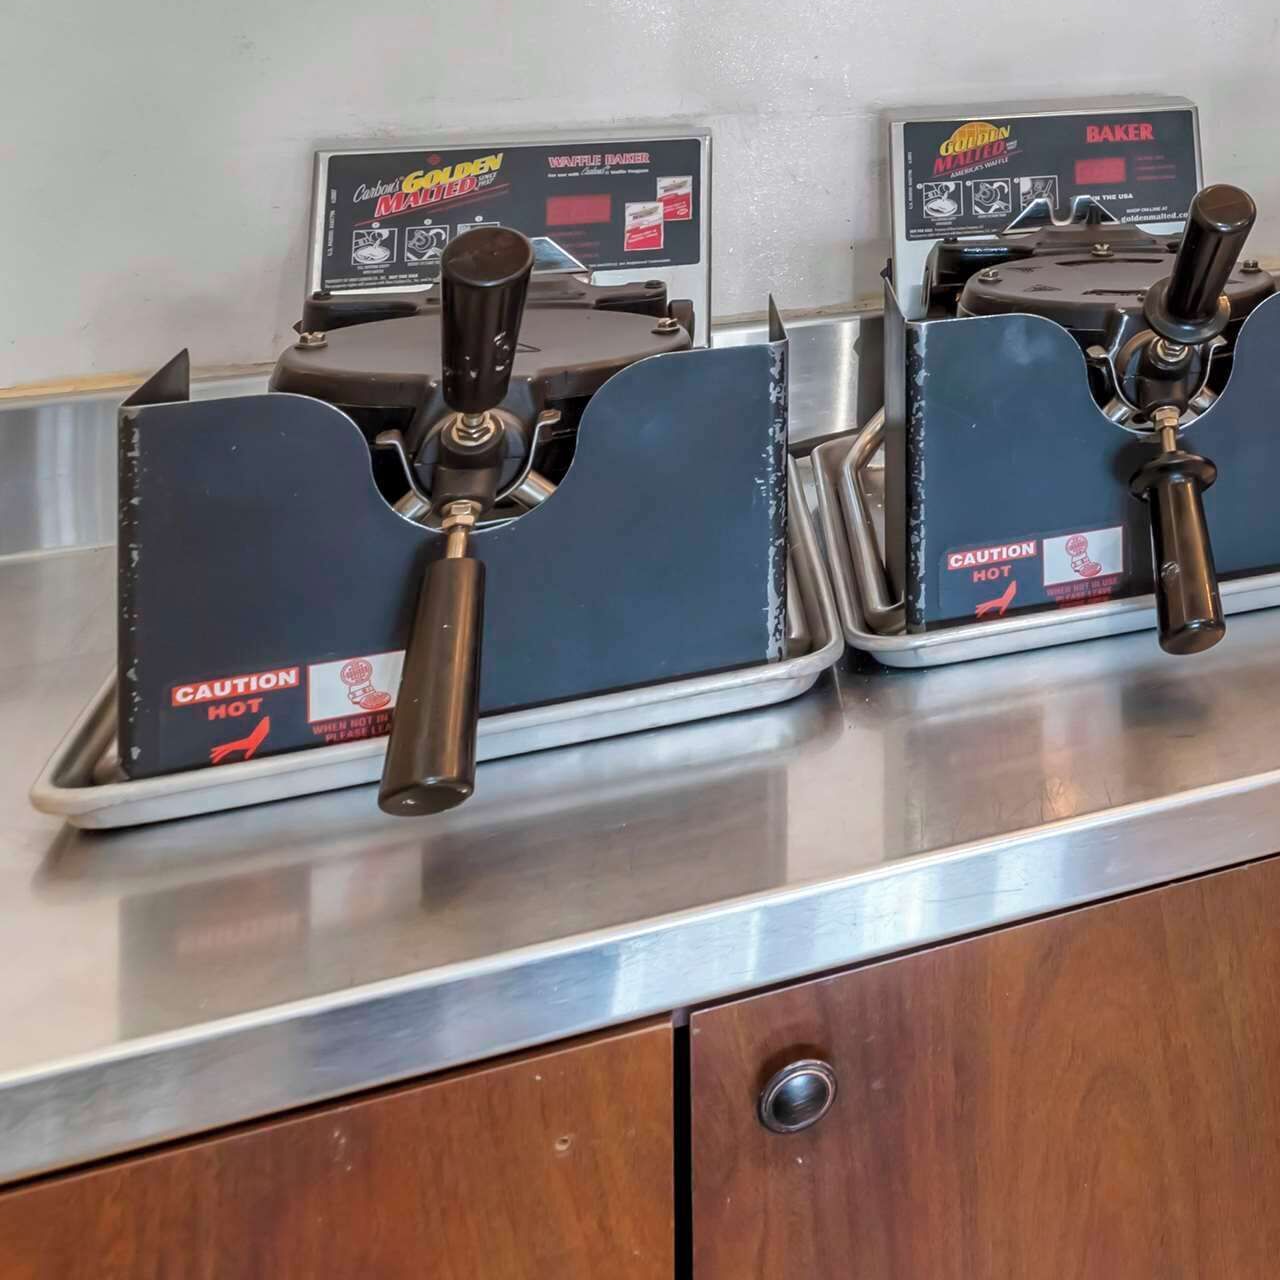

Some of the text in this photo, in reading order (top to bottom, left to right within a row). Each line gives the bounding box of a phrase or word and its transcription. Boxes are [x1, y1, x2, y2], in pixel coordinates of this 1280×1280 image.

[939, 124, 1010, 156] GOLDEN
[1085, 122, 1154, 144] BAKER
[548, 152, 651, 169] WAFFLE BAKER
[933, 140, 1005, 176] MALTED
[353, 177, 401, 204] Carbon's
[401, 153, 504, 193] GOLDEN
[374, 176, 477, 217] MALTED
[950, 543, 1035, 567] CAUTION
[973, 565, 1012, 583] HOT
[175, 671, 296, 703] CAUTION
[207, 698, 263, 721] HOT
[312, 720, 347, 735] WHEN
[350, 717, 374, 729] NOT
[325, 726, 368, 743] PLEASE
